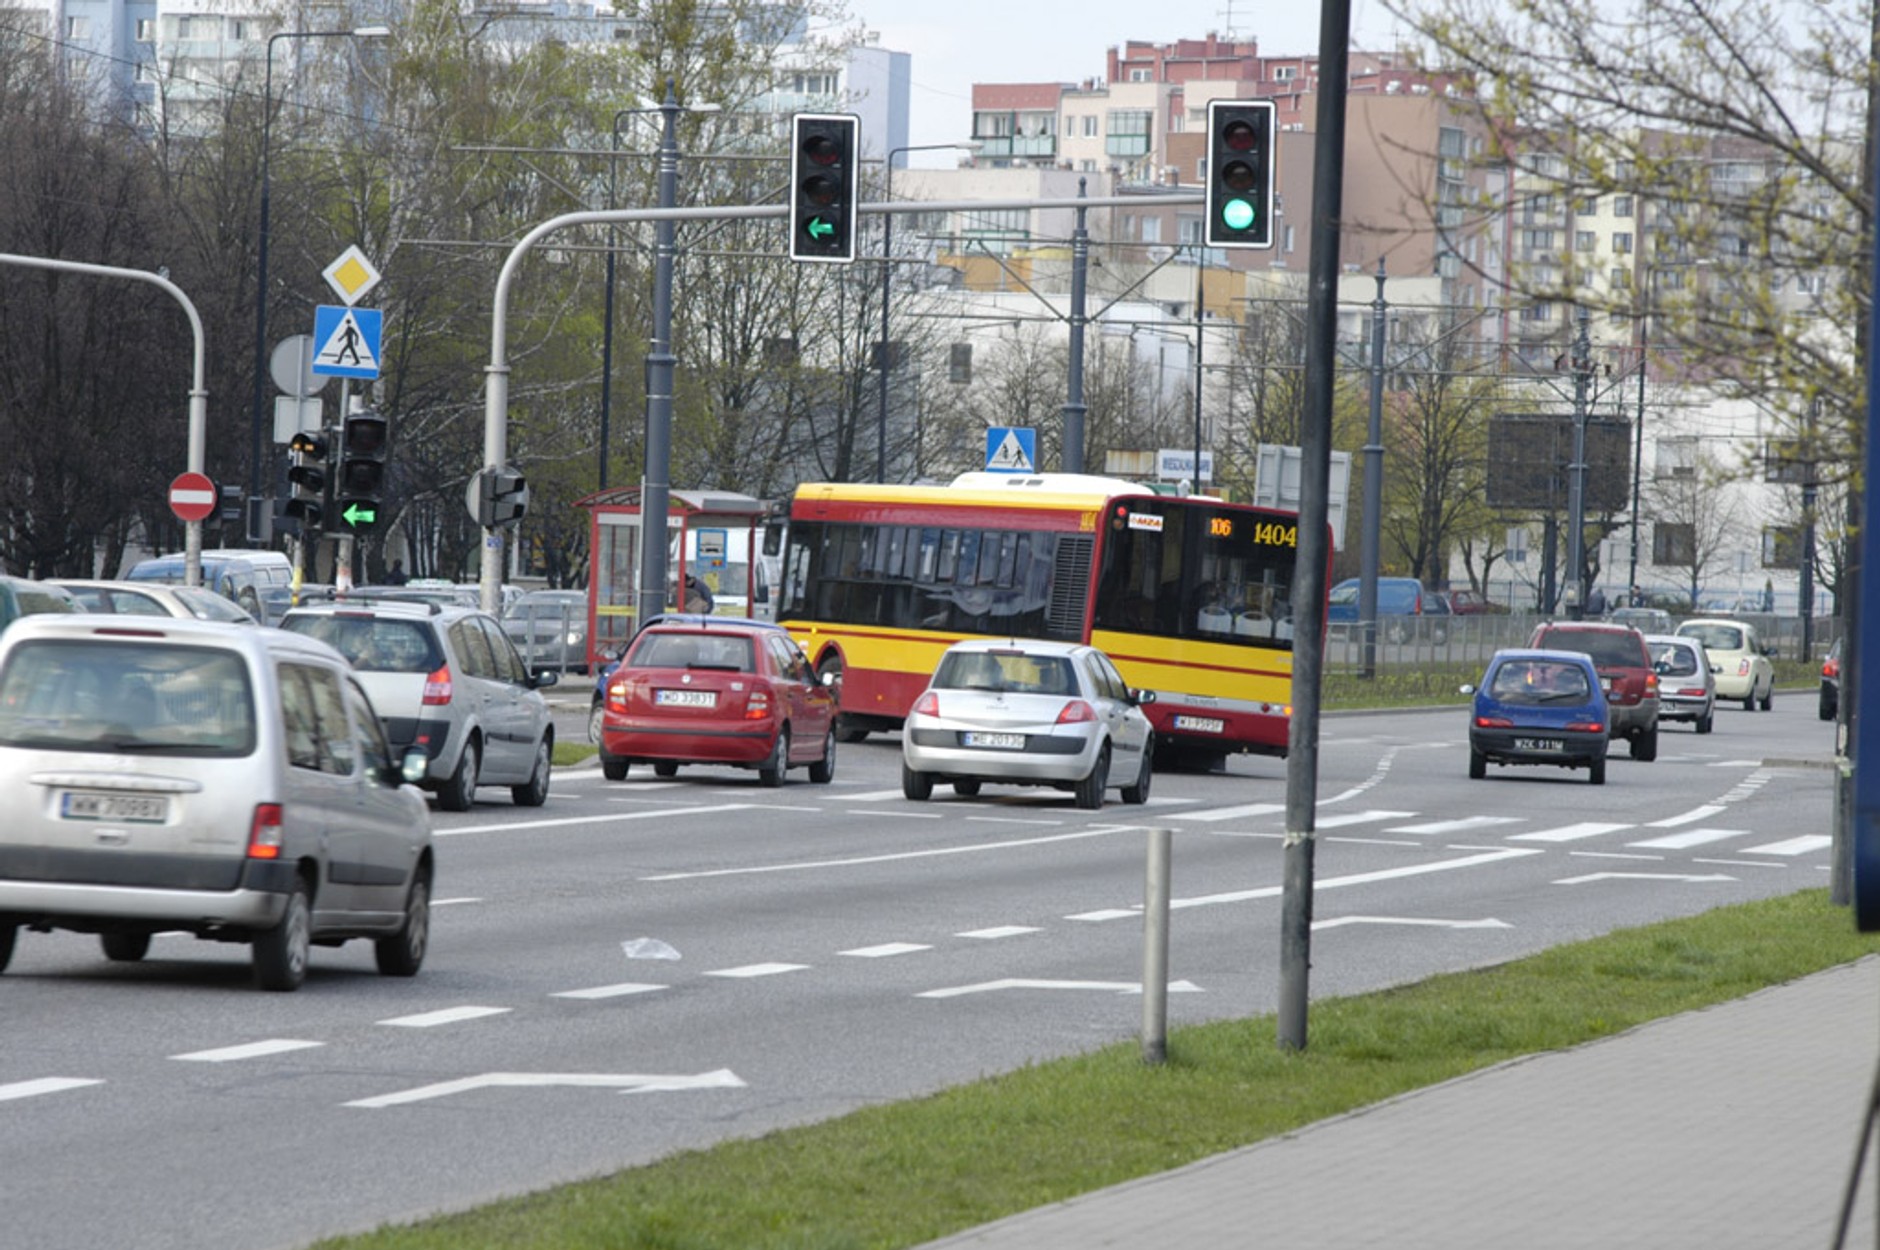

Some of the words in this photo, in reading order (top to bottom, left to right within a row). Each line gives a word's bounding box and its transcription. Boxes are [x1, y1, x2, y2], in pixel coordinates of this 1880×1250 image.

[1136, 517, 1162, 528] MZA
[1210, 517, 1232, 536] 106
[1253, 522, 1298, 548] 1404
